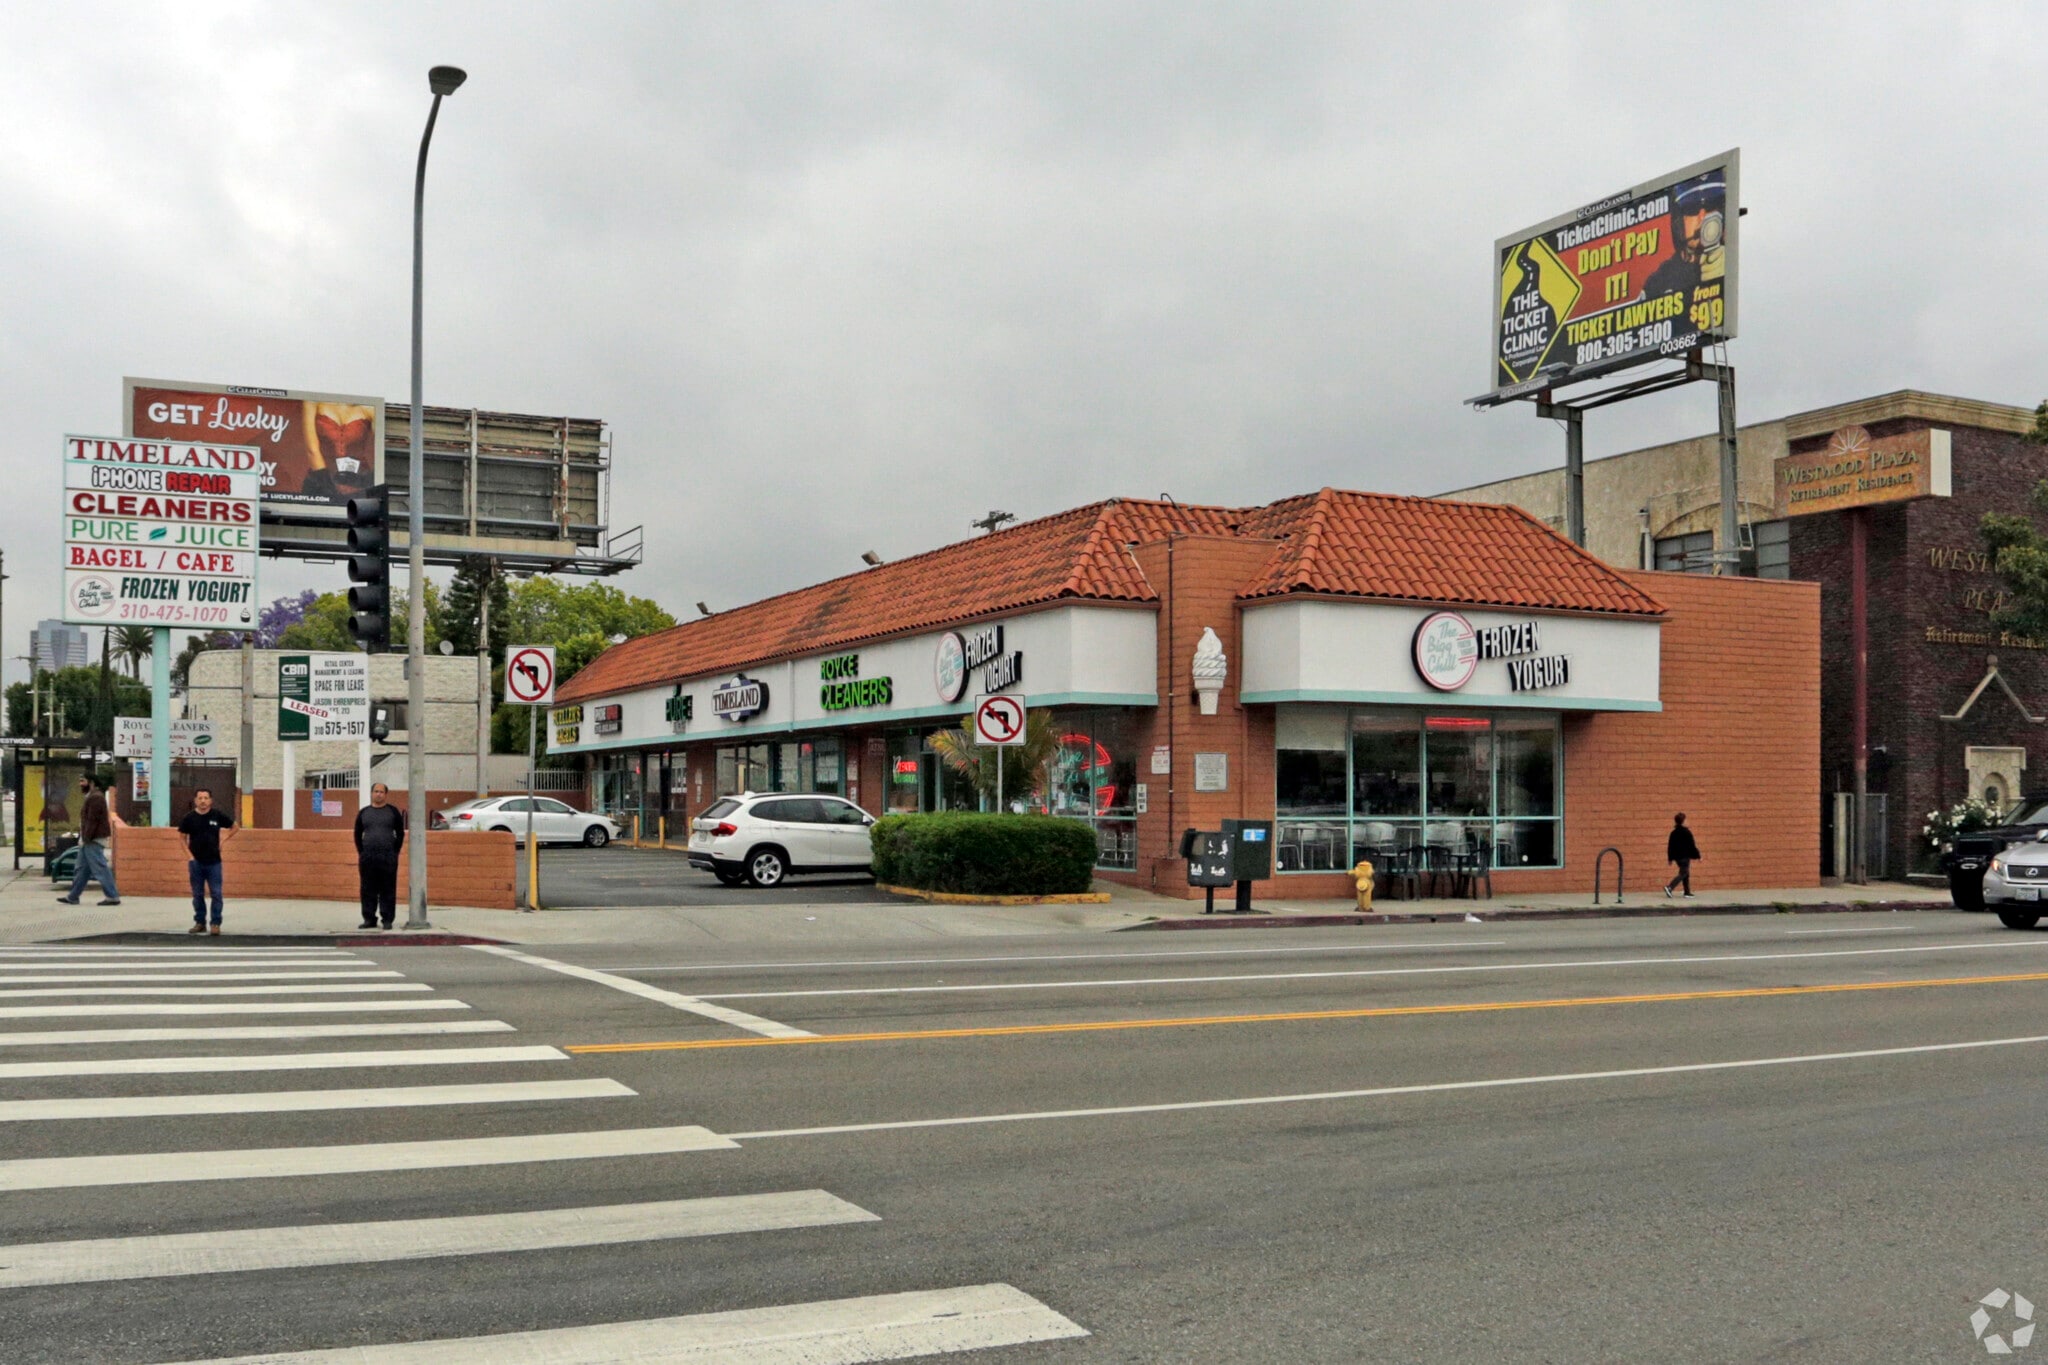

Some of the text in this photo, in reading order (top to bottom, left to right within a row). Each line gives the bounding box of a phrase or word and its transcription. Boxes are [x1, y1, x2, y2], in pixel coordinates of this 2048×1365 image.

[1556, 195, 1669, 251] TicketClinic.com
[1577, 228, 1659, 276] Don't Pay
[1513, 290, 1539, 313] THE
[1605, 272, 1629, 303] IT!
[1693, 283, 1720, 302] from
[1503, 306, 1548, 335] TICKET
[1567, 291, 1685, 346] TICKET LAWYERS
[1689, 298, 1724, 331] $99
[1502, 326, 1548, 354] CLINIC
[1576, 320, 1673, 365] 800-305-1500
[1660, 333, 1698, 355] 003662
[148, 397, 289, 443] GET Lucky
[69, 438, 256, 471] TIMELAND
[1783, 449, 1919, 485] WESTWOOD PLAZA
[92, 465, 231, 496] iPHONE REPAIR
[1790, 472, 1913, 502] RETIREMENT RESIDENCE
[73, 492, 252, 523] CLEANERS
[72, 519, 249, 547] PURE JUICE
[70, 547, 147, 569] BAGEL
[177, 552, 235, 573] CAFE
[120, 577, 252, 604] FROZEN YOGURT
[119, 603, 228, 623] 310-475-1070
[965, 625, 998, 670] FROZEN
[1481, 621, 1541, 659] FROZEN
[821, 655, 855, 680] ROYCE
[982, 651, 1016, 693] YOGURT
[1512, 654, 1573, 691] YOGURT
[314, 680, 332, 692] SPACE
[334, 680, 345, 691] FOR
[347, 679, 364, 691] LEASE
[713, 688, 760, 713] TIMELAND
[821, 676, 889, 710] CLEANERS
[289, 700, 329, 718] LEASED
[123, 719, 211, 732] ROYC EANERS
[325, 721, 365, 735] 575-1517
